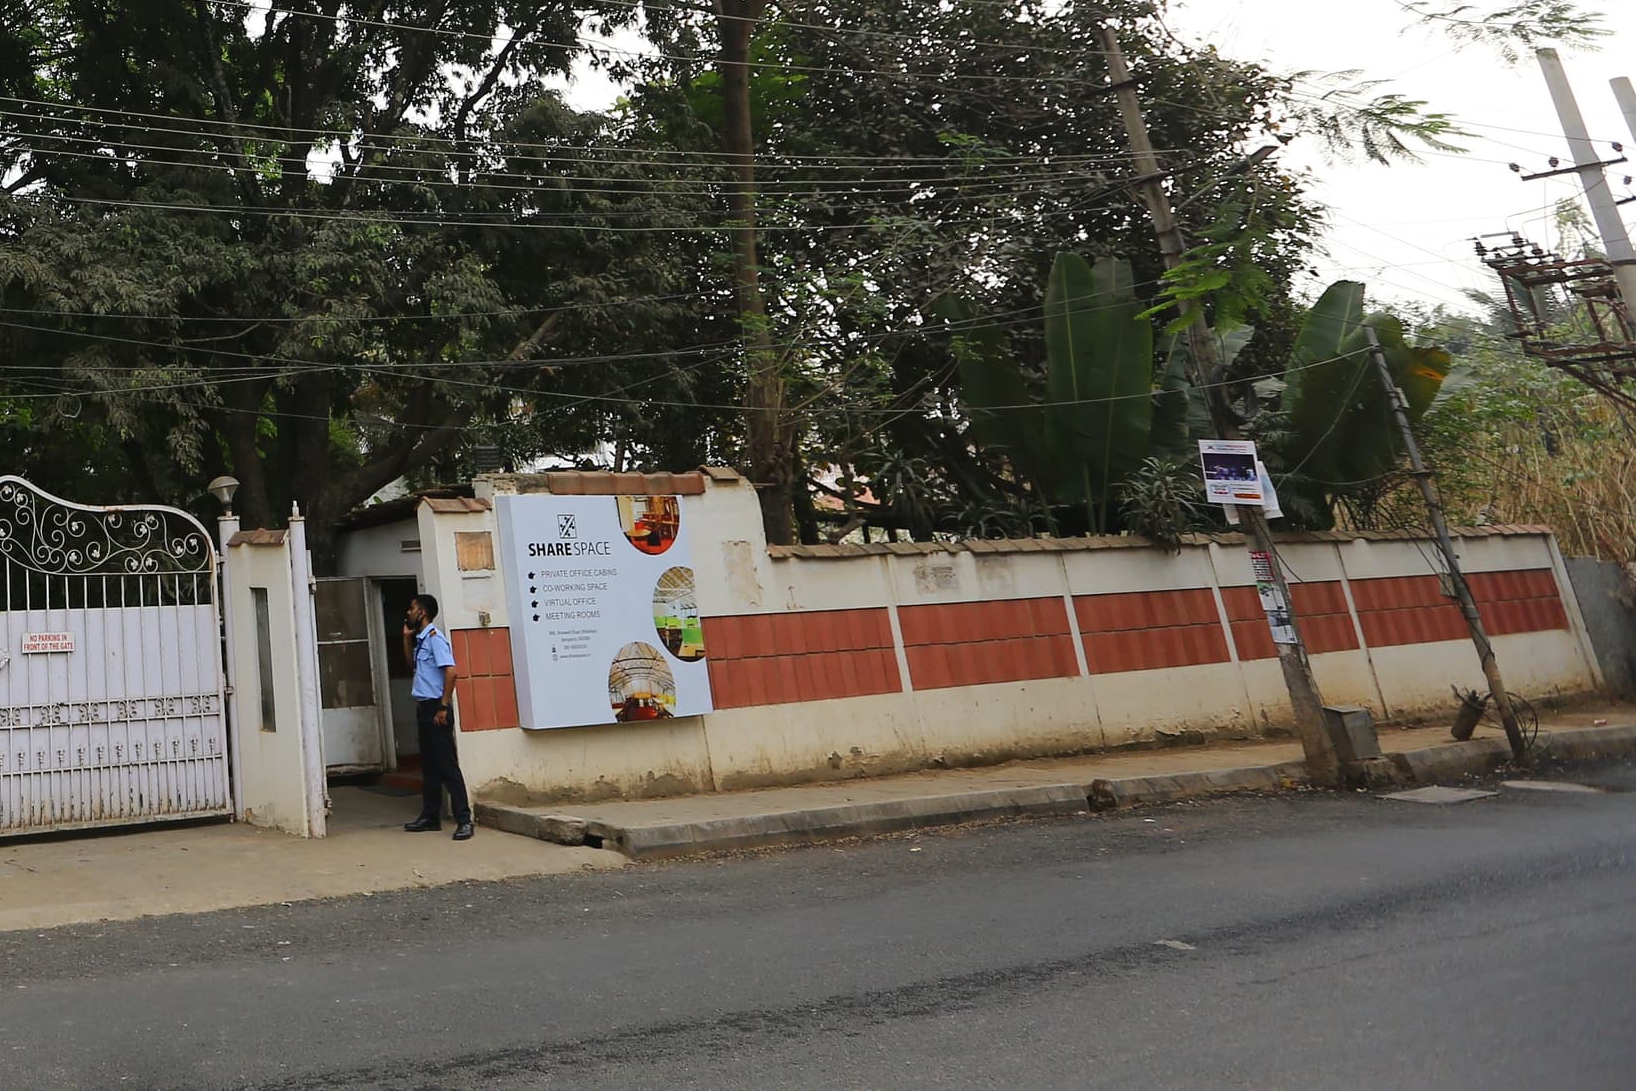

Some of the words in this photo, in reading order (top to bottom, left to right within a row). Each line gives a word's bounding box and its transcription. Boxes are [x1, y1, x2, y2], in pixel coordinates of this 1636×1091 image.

[528, 542, 572, 556] SHARE
[573, 541, 611, 556] SPACE
[540, 570, 568, 578] PRIVATE
[569, 569, 593, 578] OFFICE
[594, 568, 617, 577] CABINS
[543, 583, 586, 592] CO-WORKING
[587, 582, 608, 591] SPACE
[544, 598, 572, 607] VIRTUAL
[572, 597, 596, 606] OFFICE
[545, 611, 575, 620] MEETING
[577, 610, 601, 619] ROOMS
[24, 643, 40, 651] FRONT
[60, 642, 73, 650] GATE
